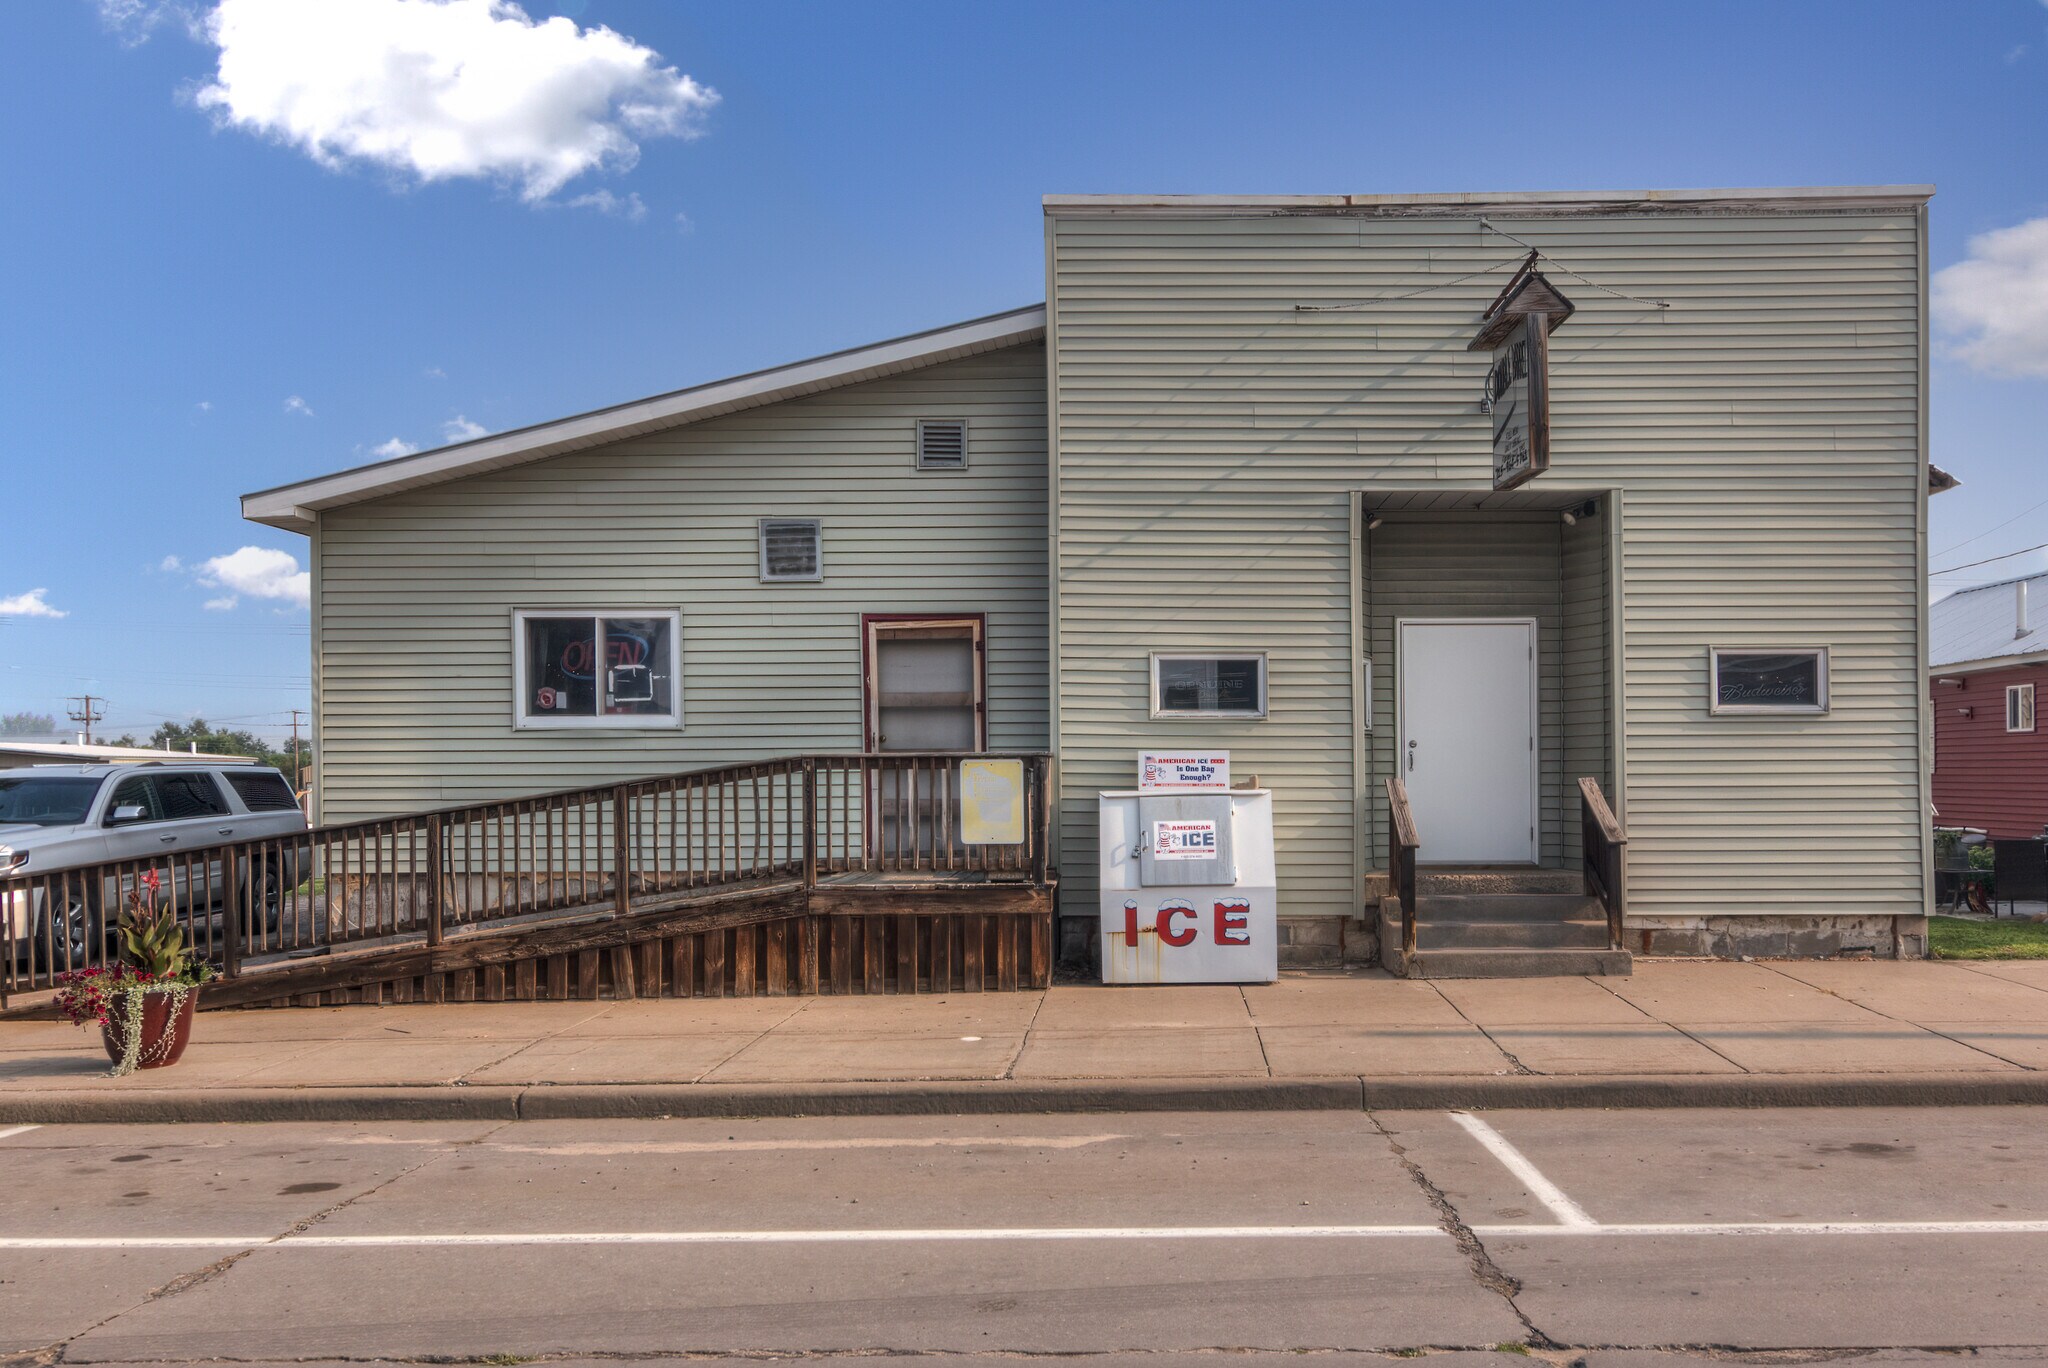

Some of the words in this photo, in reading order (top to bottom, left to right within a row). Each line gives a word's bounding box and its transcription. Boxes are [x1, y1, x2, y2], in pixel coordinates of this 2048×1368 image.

[1719, 683, 1806, 700] Budweiser
[1201, 765, 1215, 773] Bag
[1180, 774, 1212, 782] Enough?
[1182, 831, 1215, 846] ICE
[1124, 897, 1250, 947] ICE
